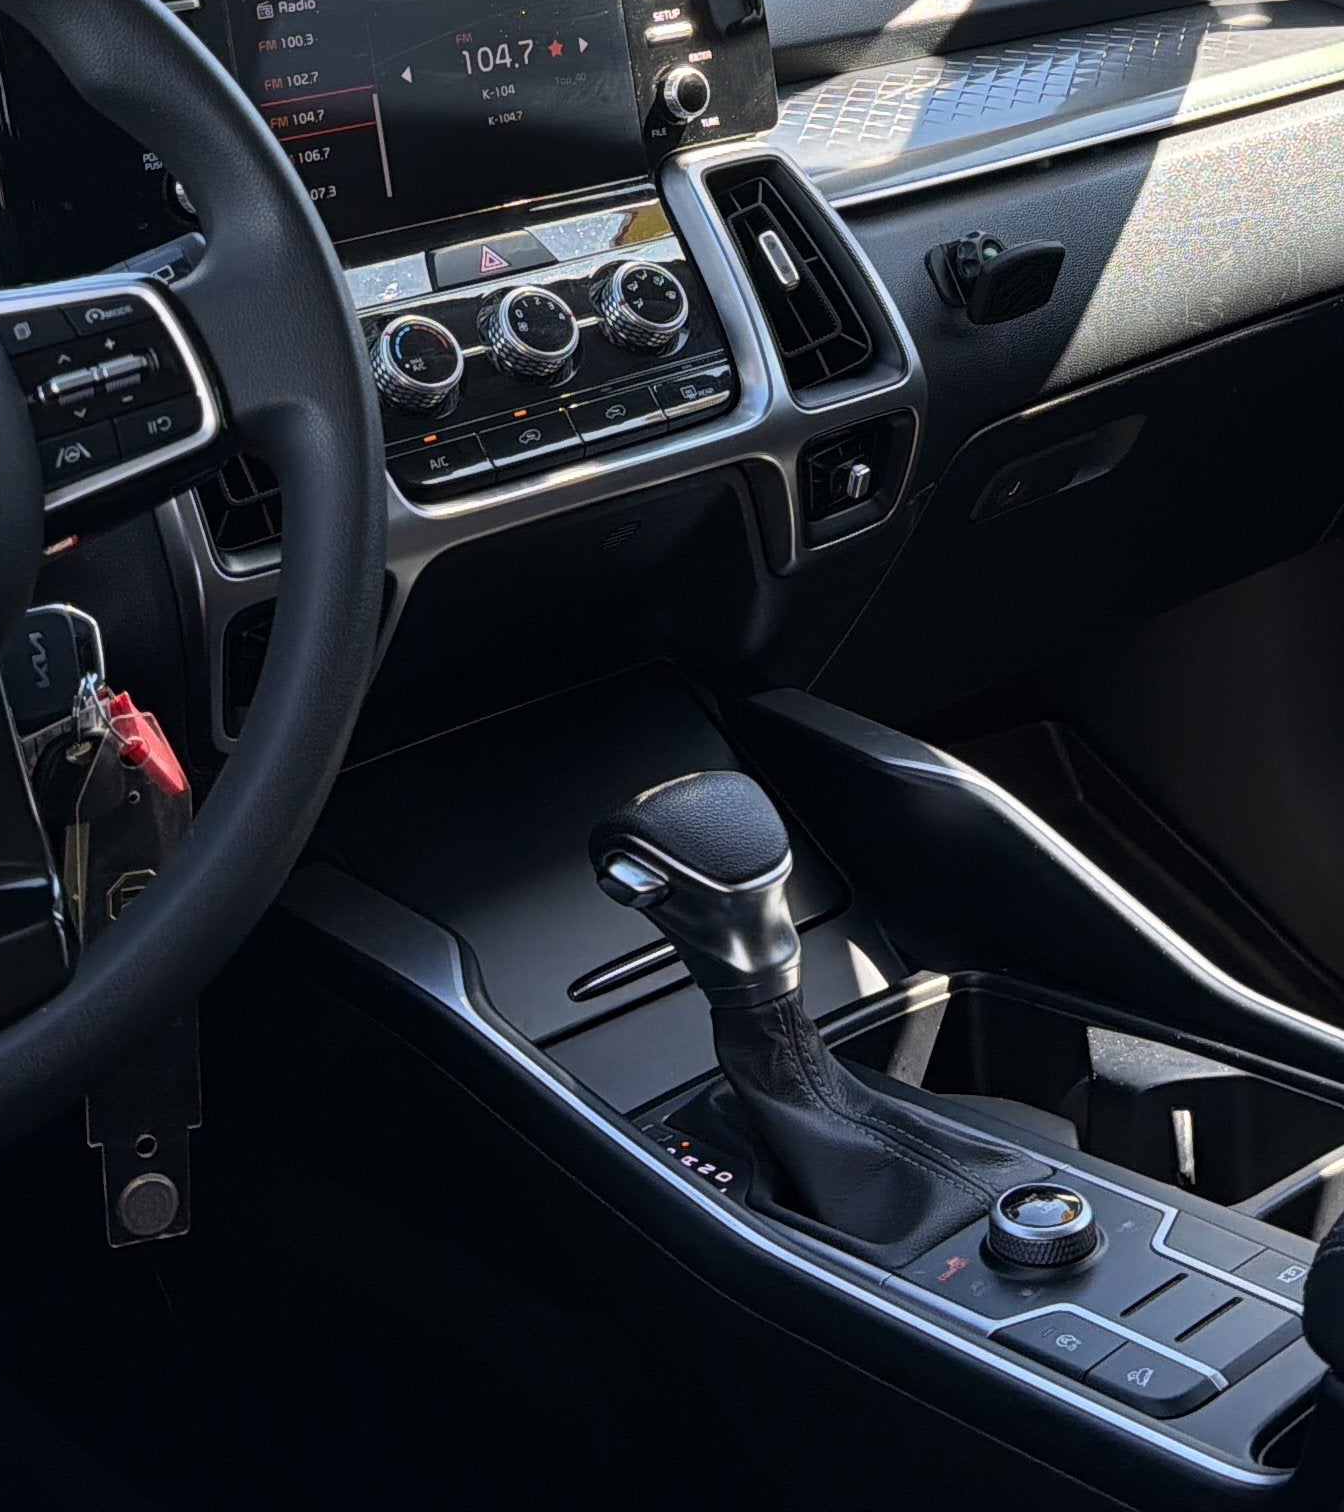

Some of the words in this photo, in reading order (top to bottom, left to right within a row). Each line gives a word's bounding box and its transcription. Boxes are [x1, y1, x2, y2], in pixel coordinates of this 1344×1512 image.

[652, 8, 681, 22] SETUP
[257, 38, 278, 53] FM
[280, 33, 315, 51] 100.3
[455, 32, 473, 46] FM
[462, 39, 534, 76] 104.7
[264, 78, 284, 92] FM
[286, 71, 319, 89] 102.7
[481, 83, 516, 101] K-104
[270, 115, 290, 129] FM
[292, 108, 326, 125] 104.7
[487, 110, 524, 127] K-104.7
[651, 126, 668, 138] FILE
[297, 146, 332, 165] 106.7
[309, 184, 338, 202] 07.3
[533, 296, 542, 306] 2
[429, 455, 450, 471] A/C
[714, 1171, 734, 1183] D
